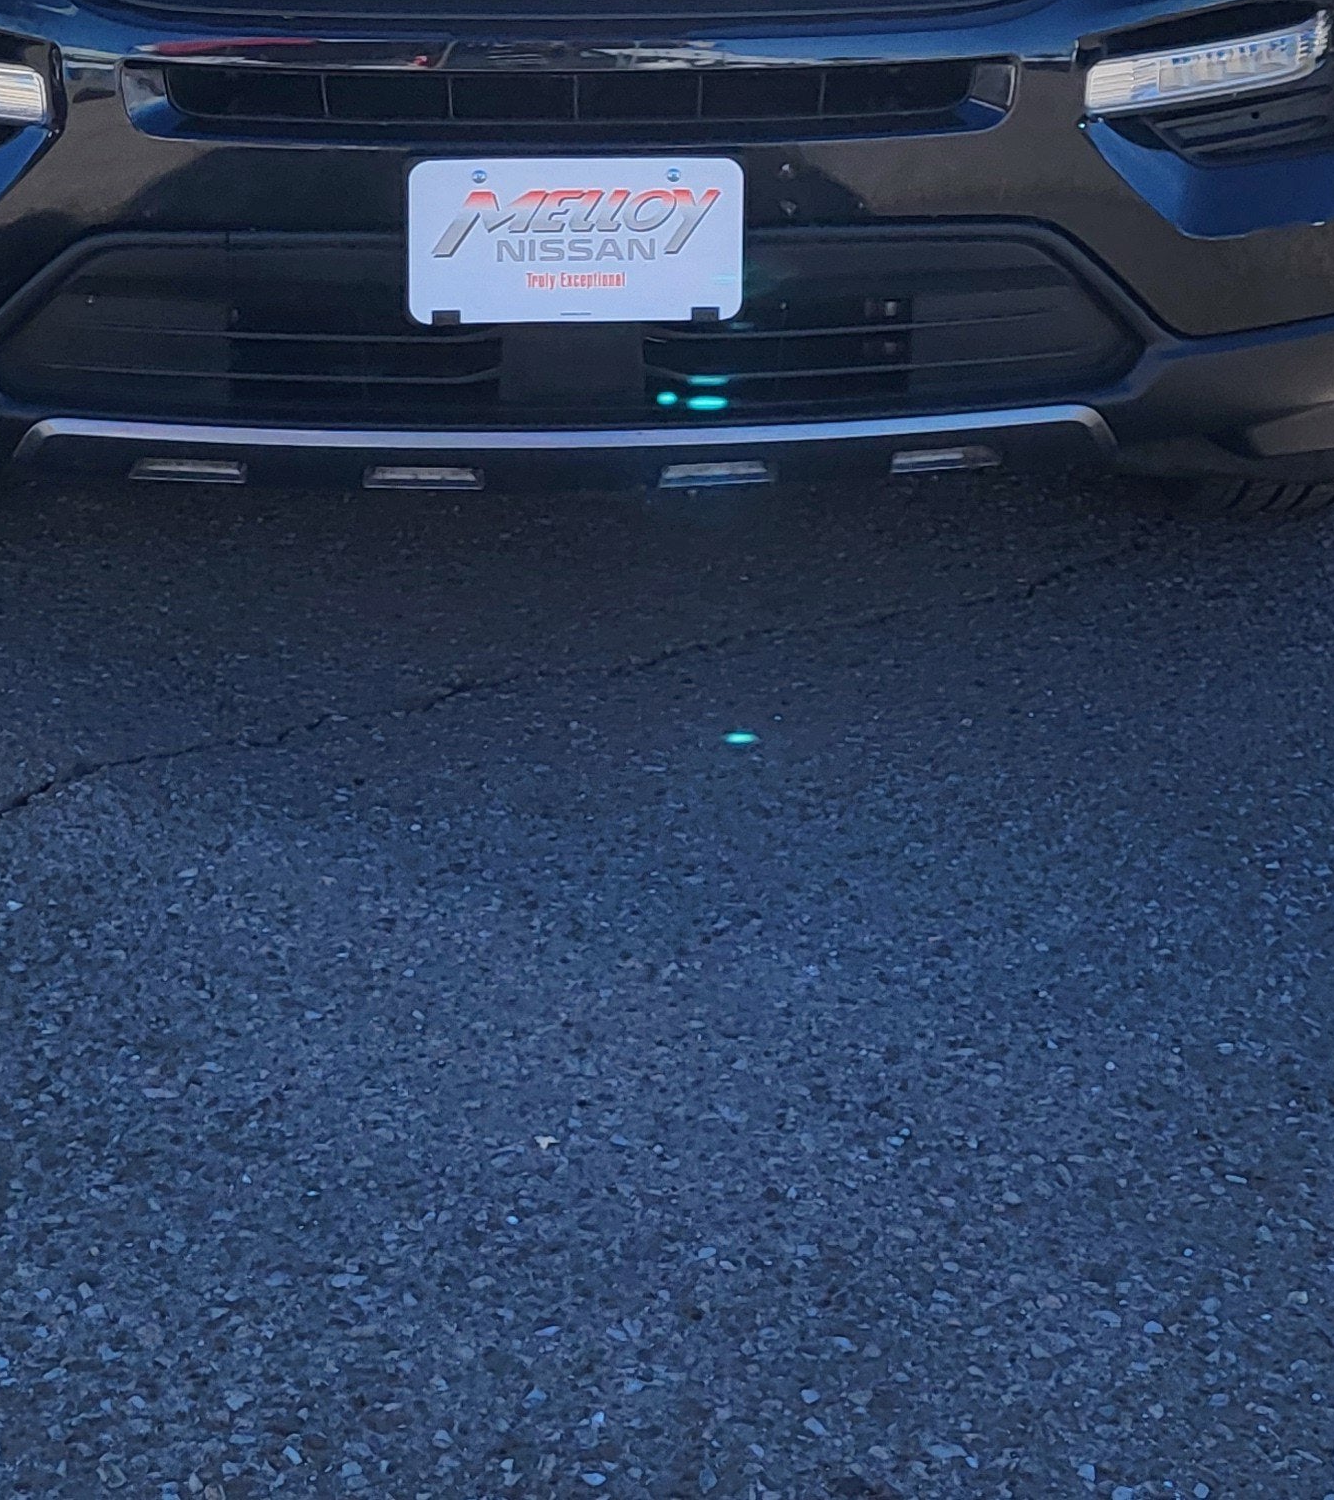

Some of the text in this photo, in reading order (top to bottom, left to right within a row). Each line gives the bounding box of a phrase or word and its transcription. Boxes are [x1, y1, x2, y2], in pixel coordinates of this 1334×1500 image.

[496, 239, 656, 262] NISSAN
[526, 272, 626, 289] Truly Exceptional
